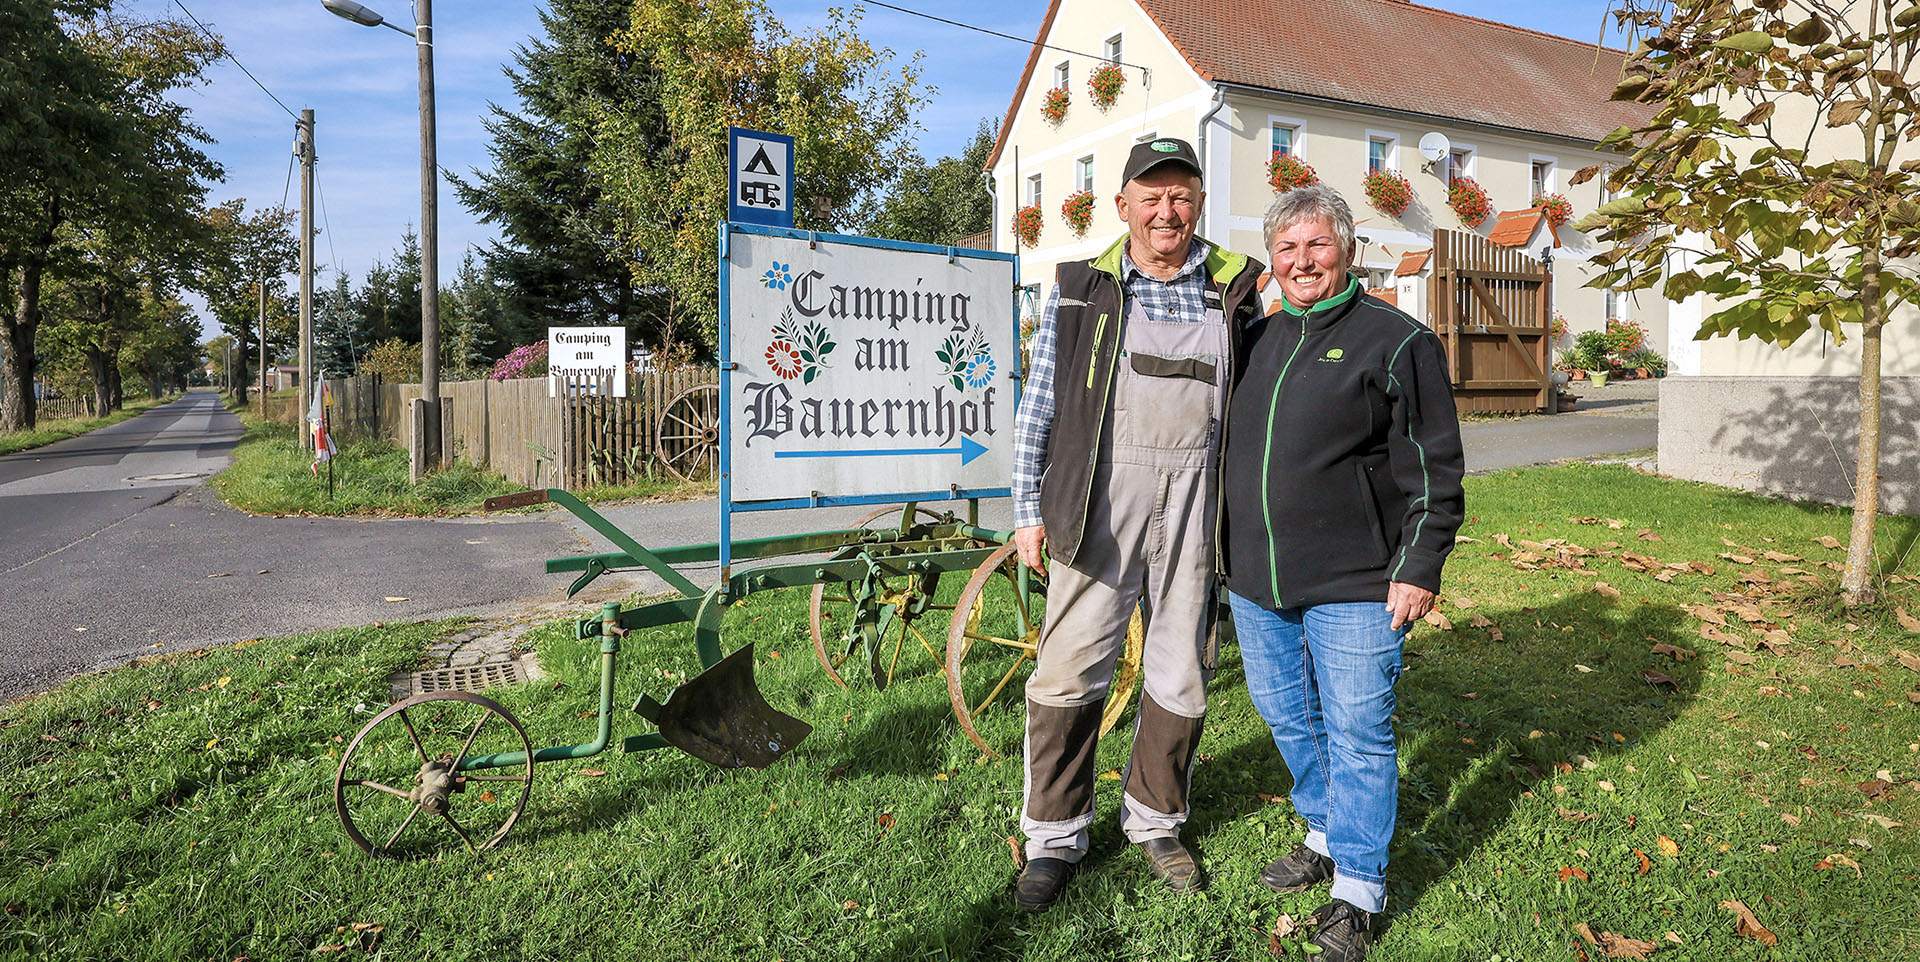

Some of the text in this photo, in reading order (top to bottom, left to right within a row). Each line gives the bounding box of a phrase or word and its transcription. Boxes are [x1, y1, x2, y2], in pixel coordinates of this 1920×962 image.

[791, 269, 971, 332] Camping
[555, 332, 611, 347] Camping
[575, 352, 593, 360] am
[854, 337, 910, 371] am
[743, 381, 997, 448] Bauernhof
